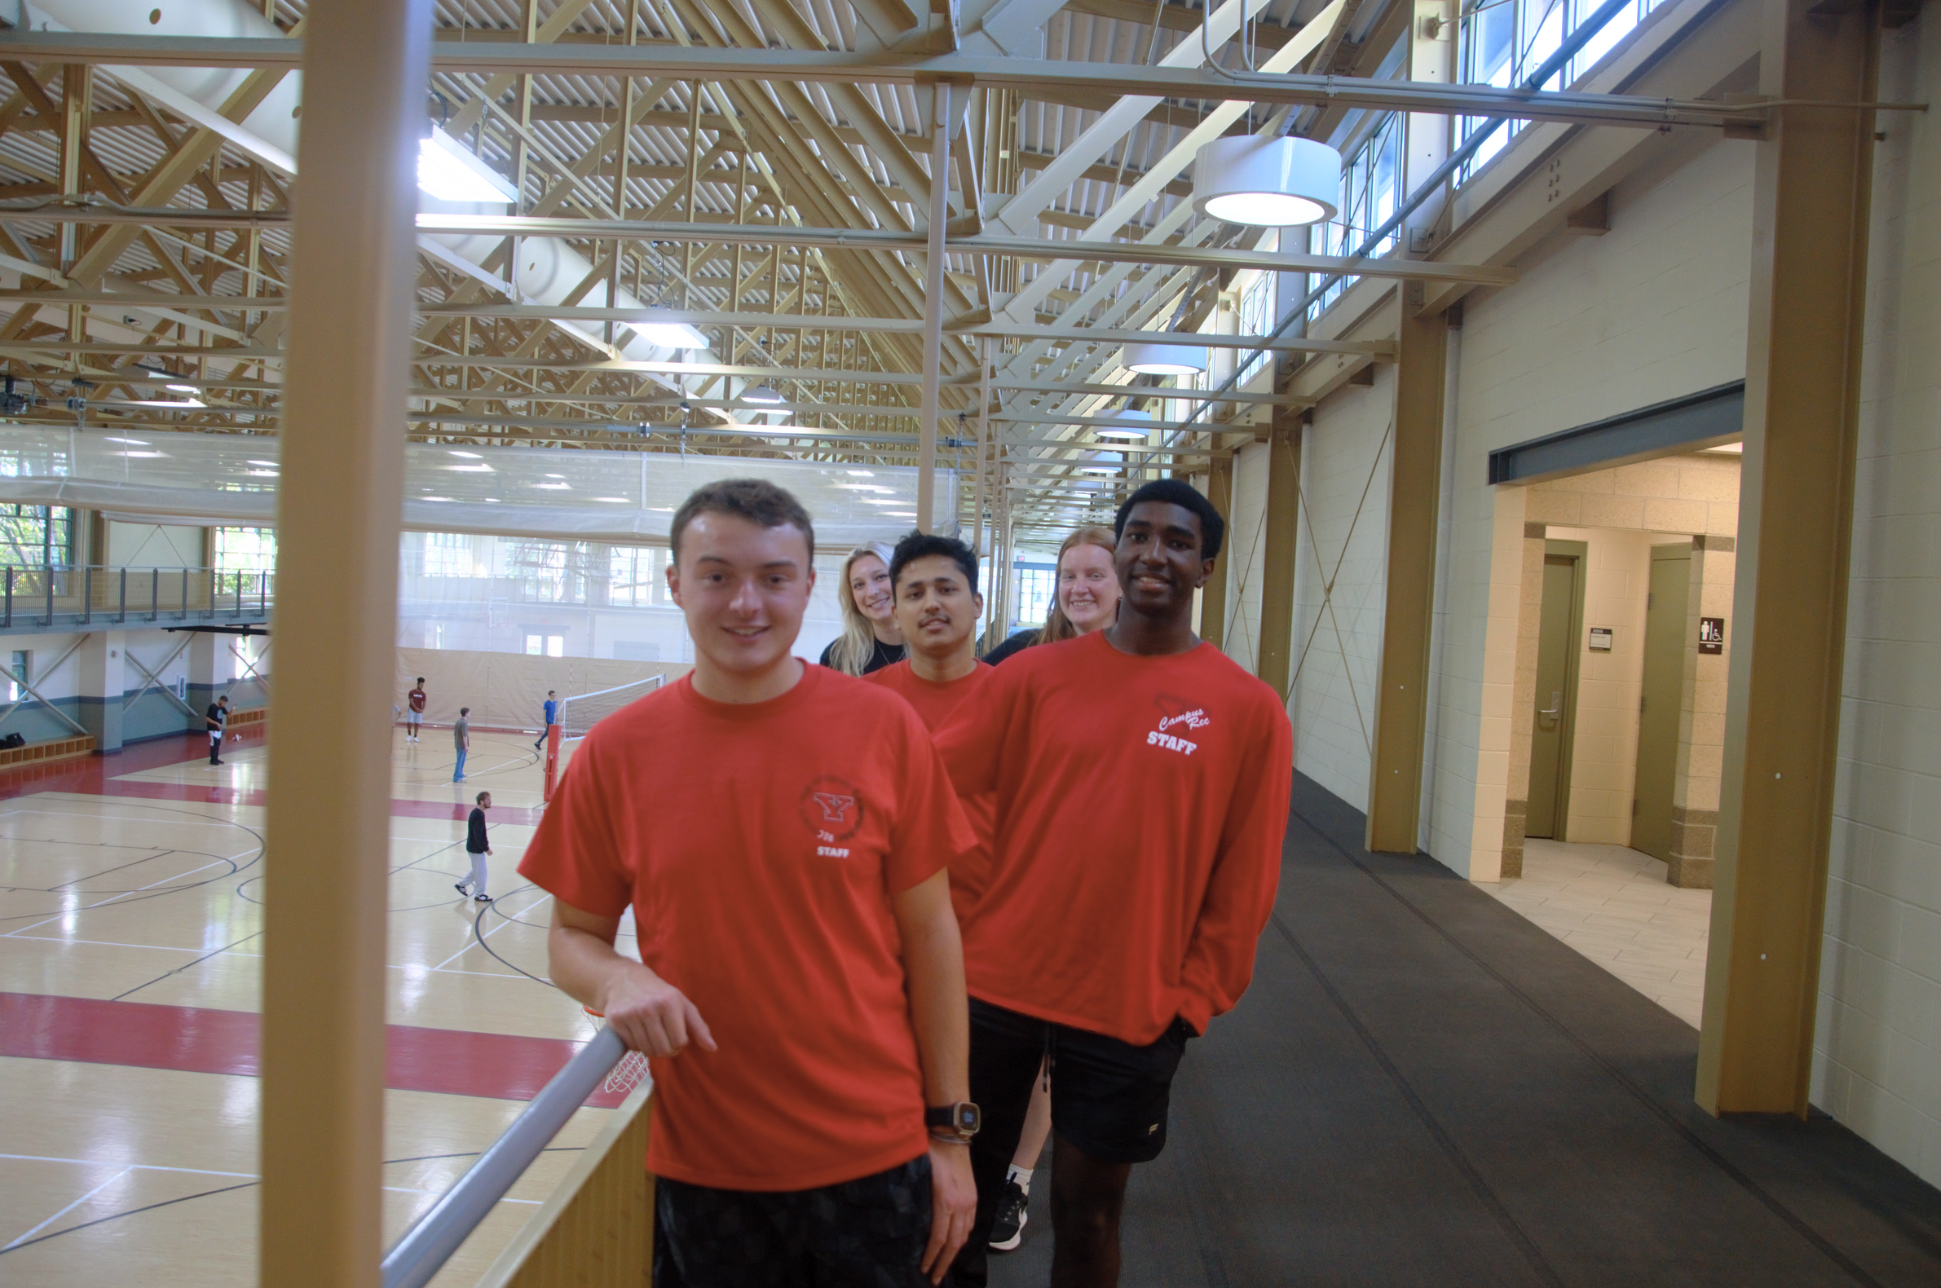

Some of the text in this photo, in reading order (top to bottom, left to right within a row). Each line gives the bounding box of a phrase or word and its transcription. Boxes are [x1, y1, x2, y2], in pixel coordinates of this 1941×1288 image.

[1159, 708, 1204, 731] Campus
[1186, 717, 1210, 730] Rec
[1147, 731, 1197, 755] STAFF
[817, 846, 849, 858] STAFF
